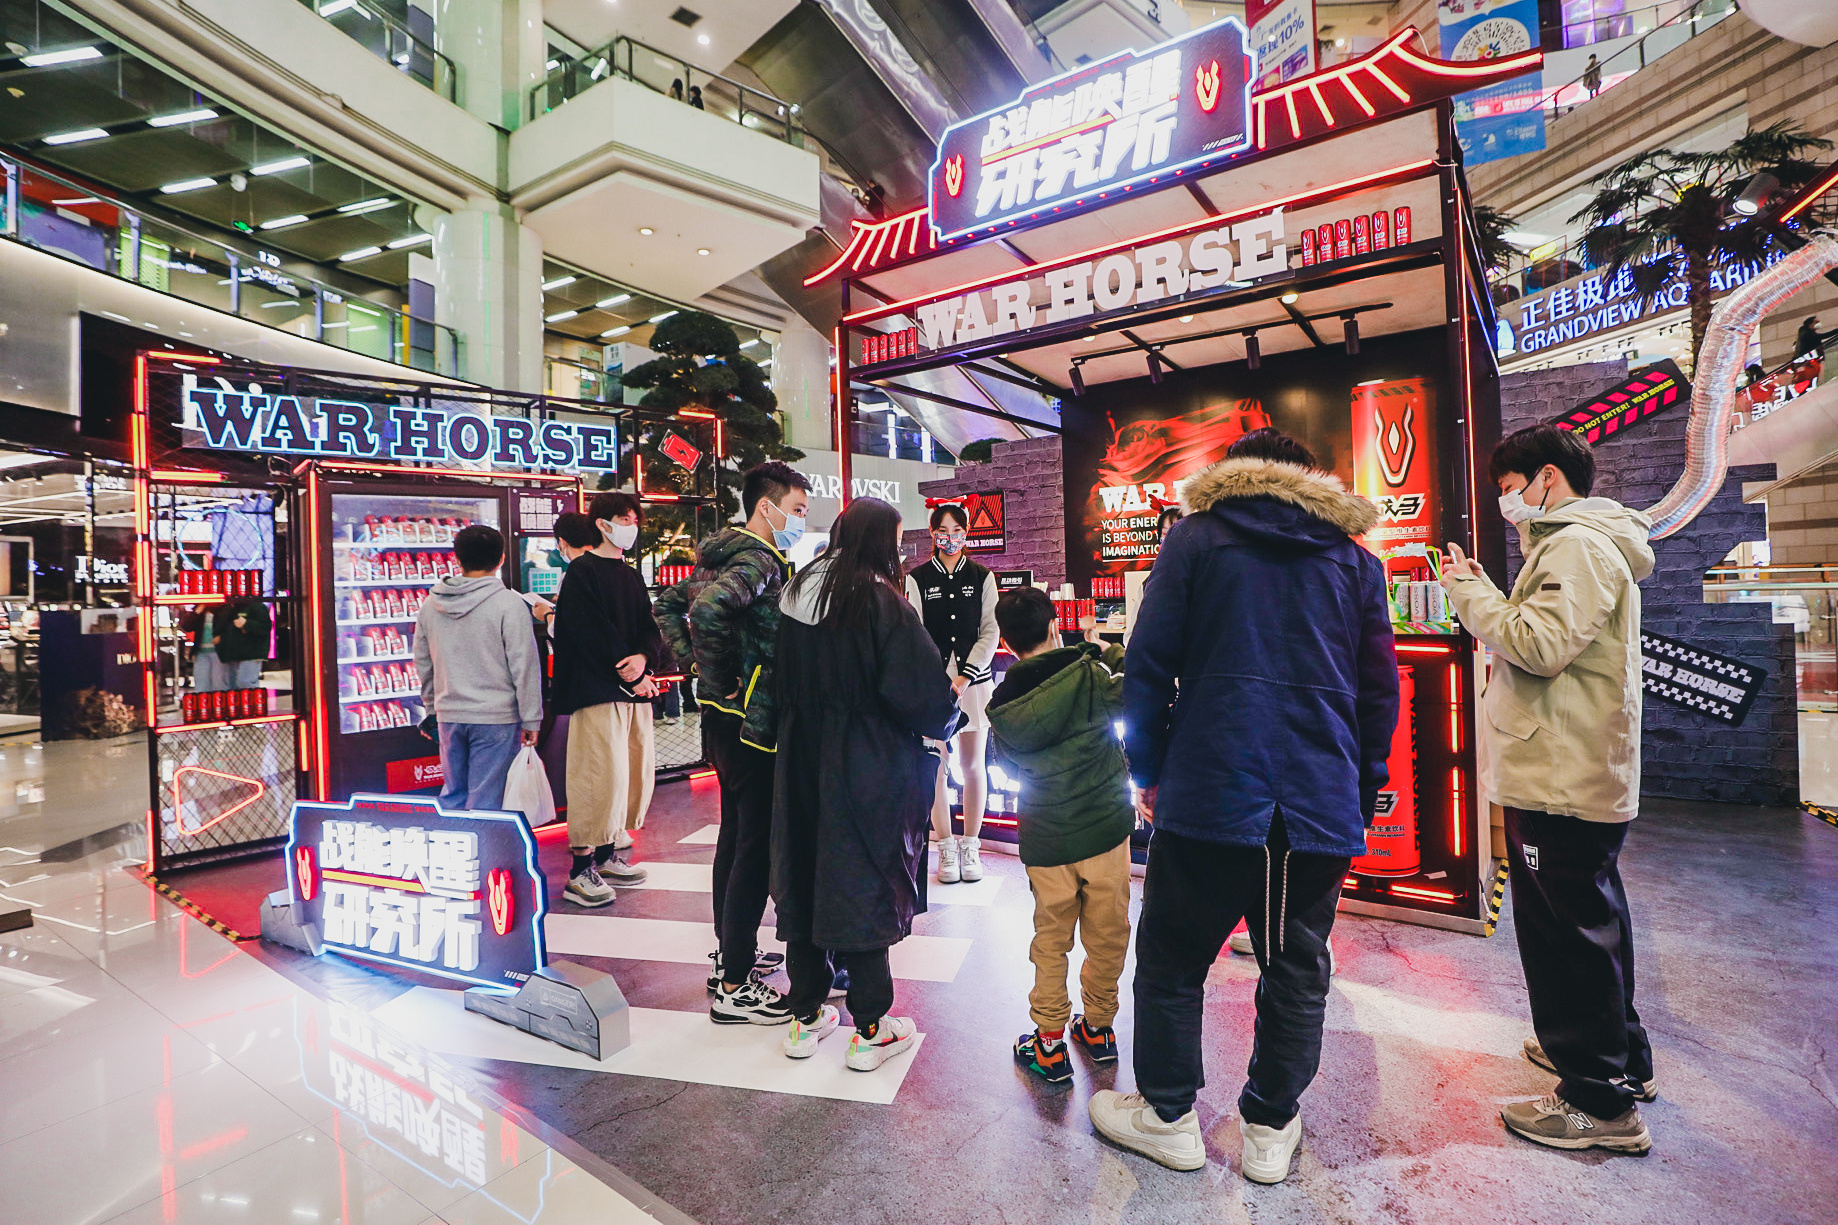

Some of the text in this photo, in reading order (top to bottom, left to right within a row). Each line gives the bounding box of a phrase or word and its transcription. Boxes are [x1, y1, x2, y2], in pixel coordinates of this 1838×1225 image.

[981, 50, 1182, 157] 战能唤醒
[975, 100, 1178, 218] 研究所
[917, 216, 1288, 351] WAR HORSE
[1520, 297, 1643, 353] GRANDVIEW
[189, 390, 380, 456] WAR
[389, 407, 618, 473] HORSE
[1584, 417, 1601, 430] NOT
[1600, 402, 1631, 421] ENTER!
[1631, 392, 1650, 404] WAR
[1648, 378, 1675, 396] HORSE
[1099, 483, 1168, 513] WAR
[1101, 516, 1158, 530] YOUR ENER
[980, 538, 1003, 547] HORSE
[1102, 530, 1153, 543] IS BEYOND
[1672, 667, 1746, 704] HORSE
[319, 820, 480, 902] 战能唤醒
[322, 881, 482, 972] 研究所
